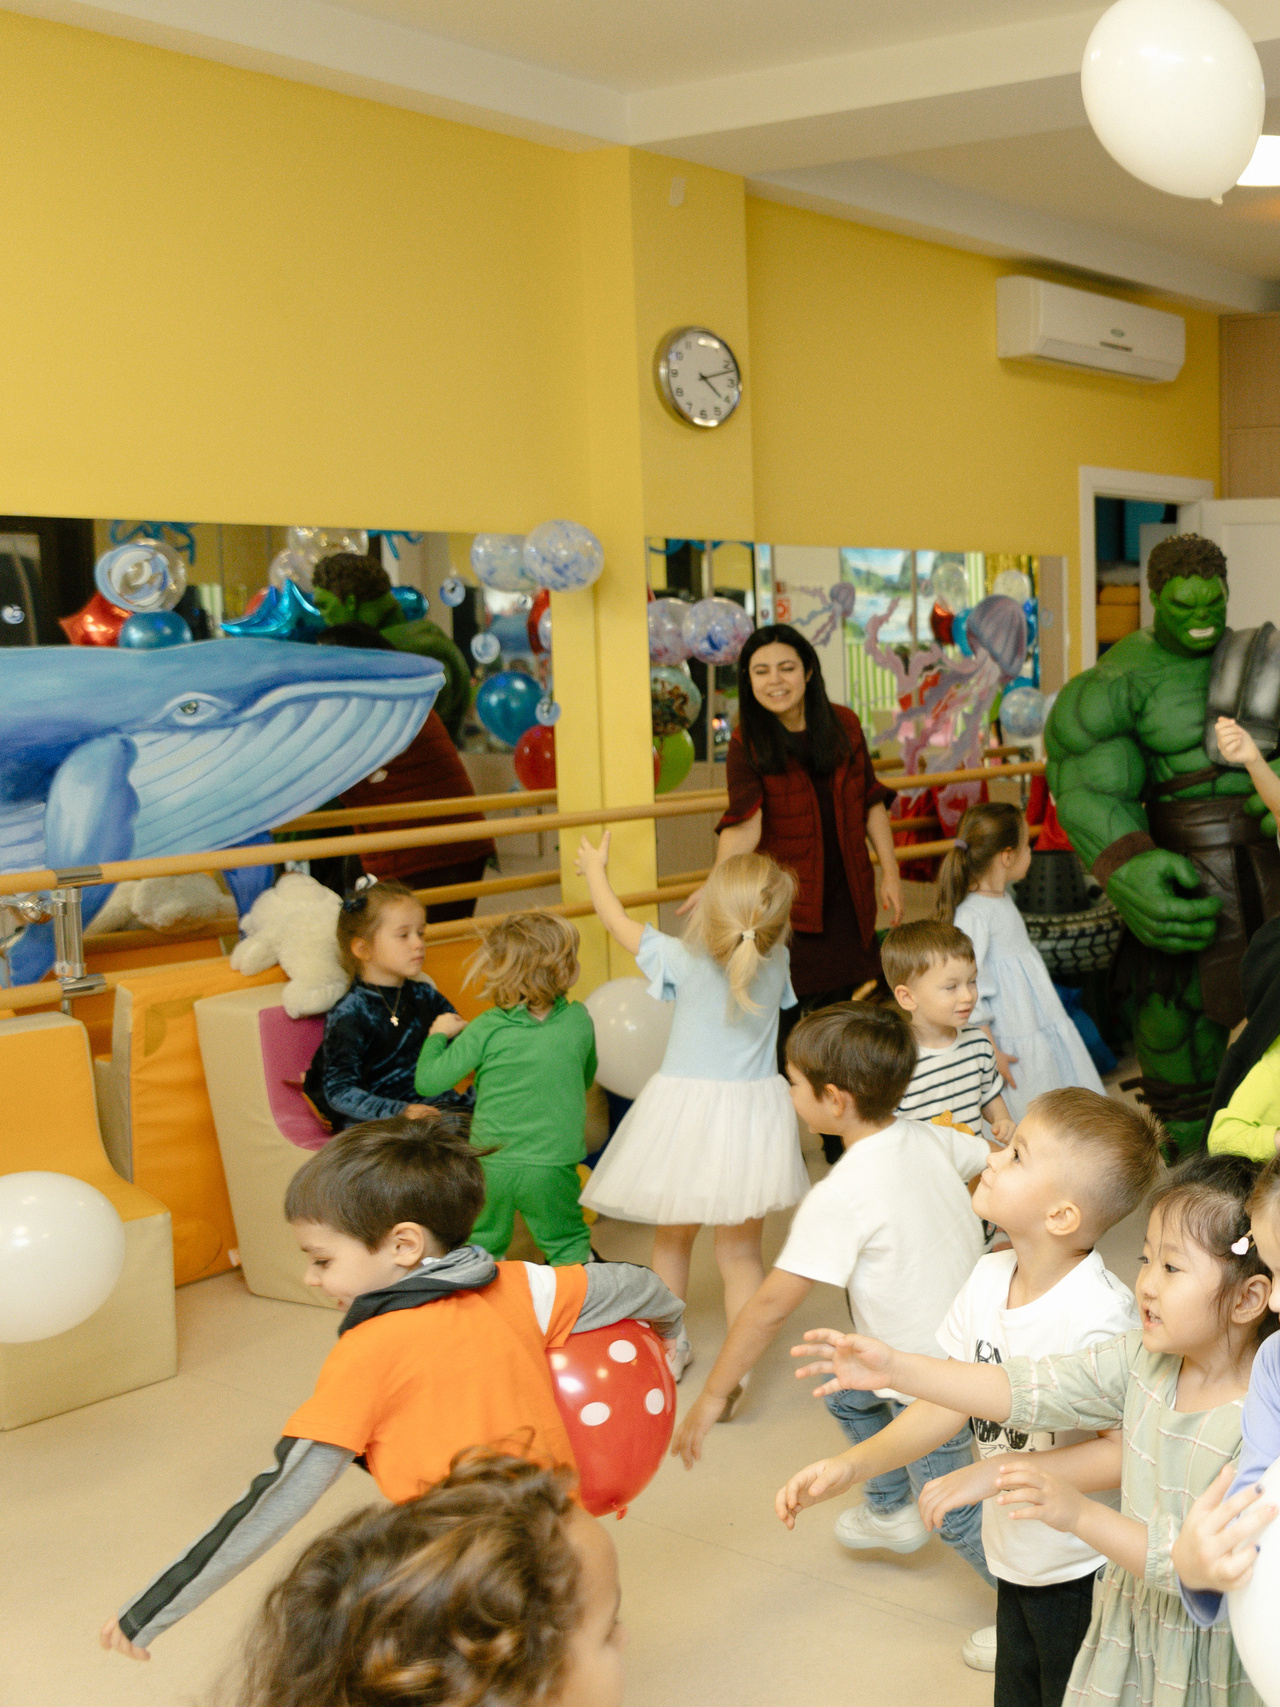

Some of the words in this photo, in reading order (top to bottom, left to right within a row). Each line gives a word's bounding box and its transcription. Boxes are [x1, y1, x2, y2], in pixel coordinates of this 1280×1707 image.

[722, 359, 732, 370] 2
[671, 368, 679, 378] 9
[727, 378, 736, 388] 3
[675, 387, 684, 397] 8
[724, 395, 731, 404] 4
[686, 401, 693, 412] 7
[713, 406, 722, 416] 5
[699, 409, 708, 419] 6
